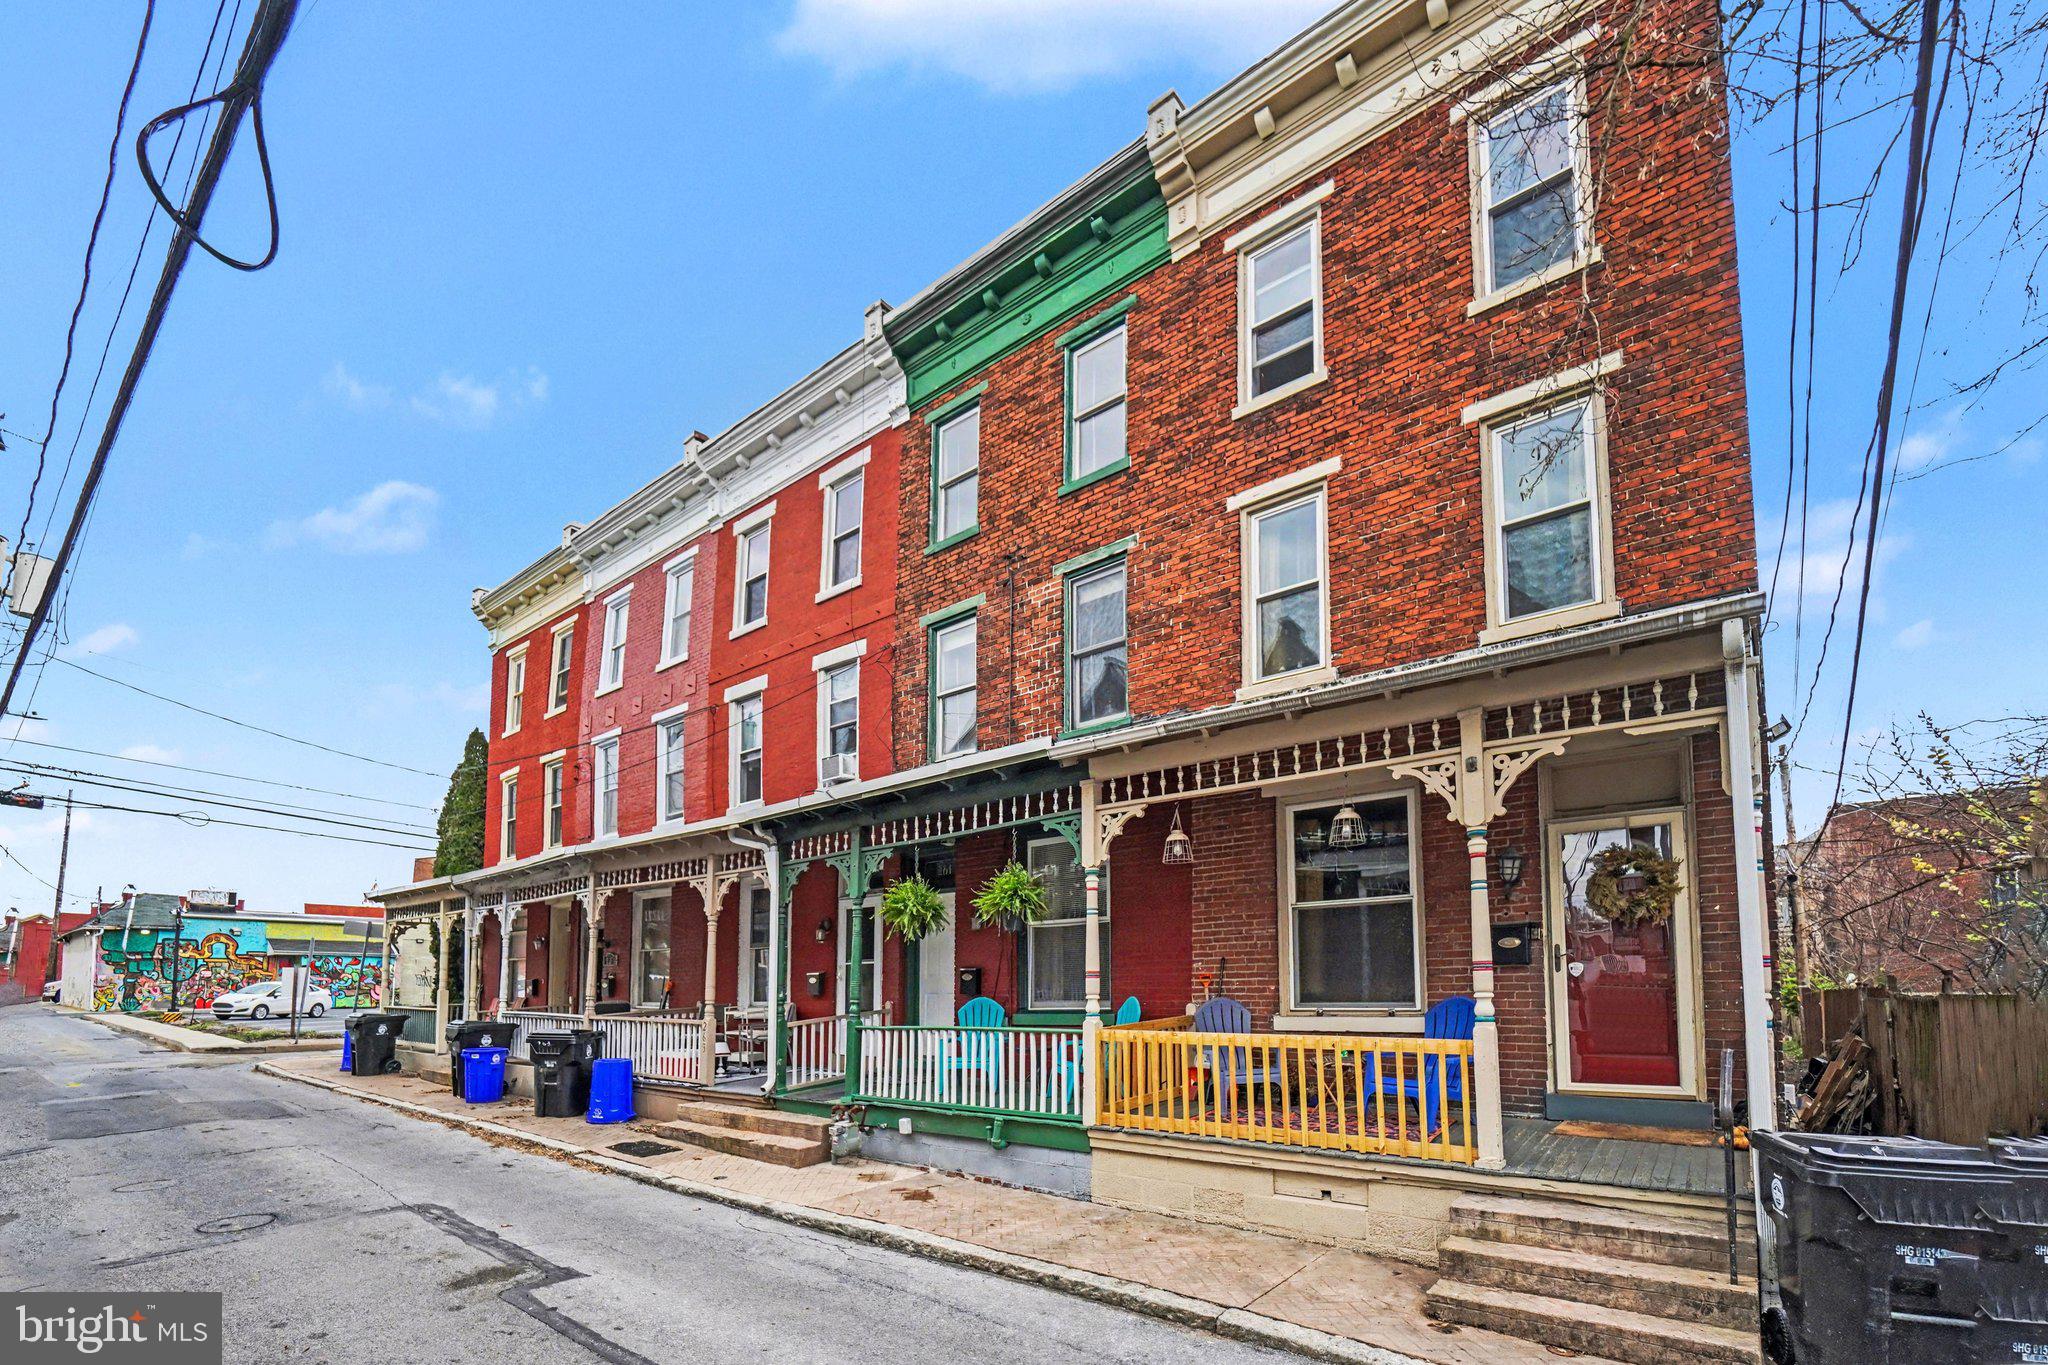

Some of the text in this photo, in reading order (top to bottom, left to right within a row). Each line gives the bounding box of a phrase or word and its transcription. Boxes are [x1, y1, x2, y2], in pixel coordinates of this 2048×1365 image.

[1895, 1244, 1914, 1257] SHG
[2034, 1244, 2048, 1256] SH
[2012, 1341, 2032, 1354] SHG
